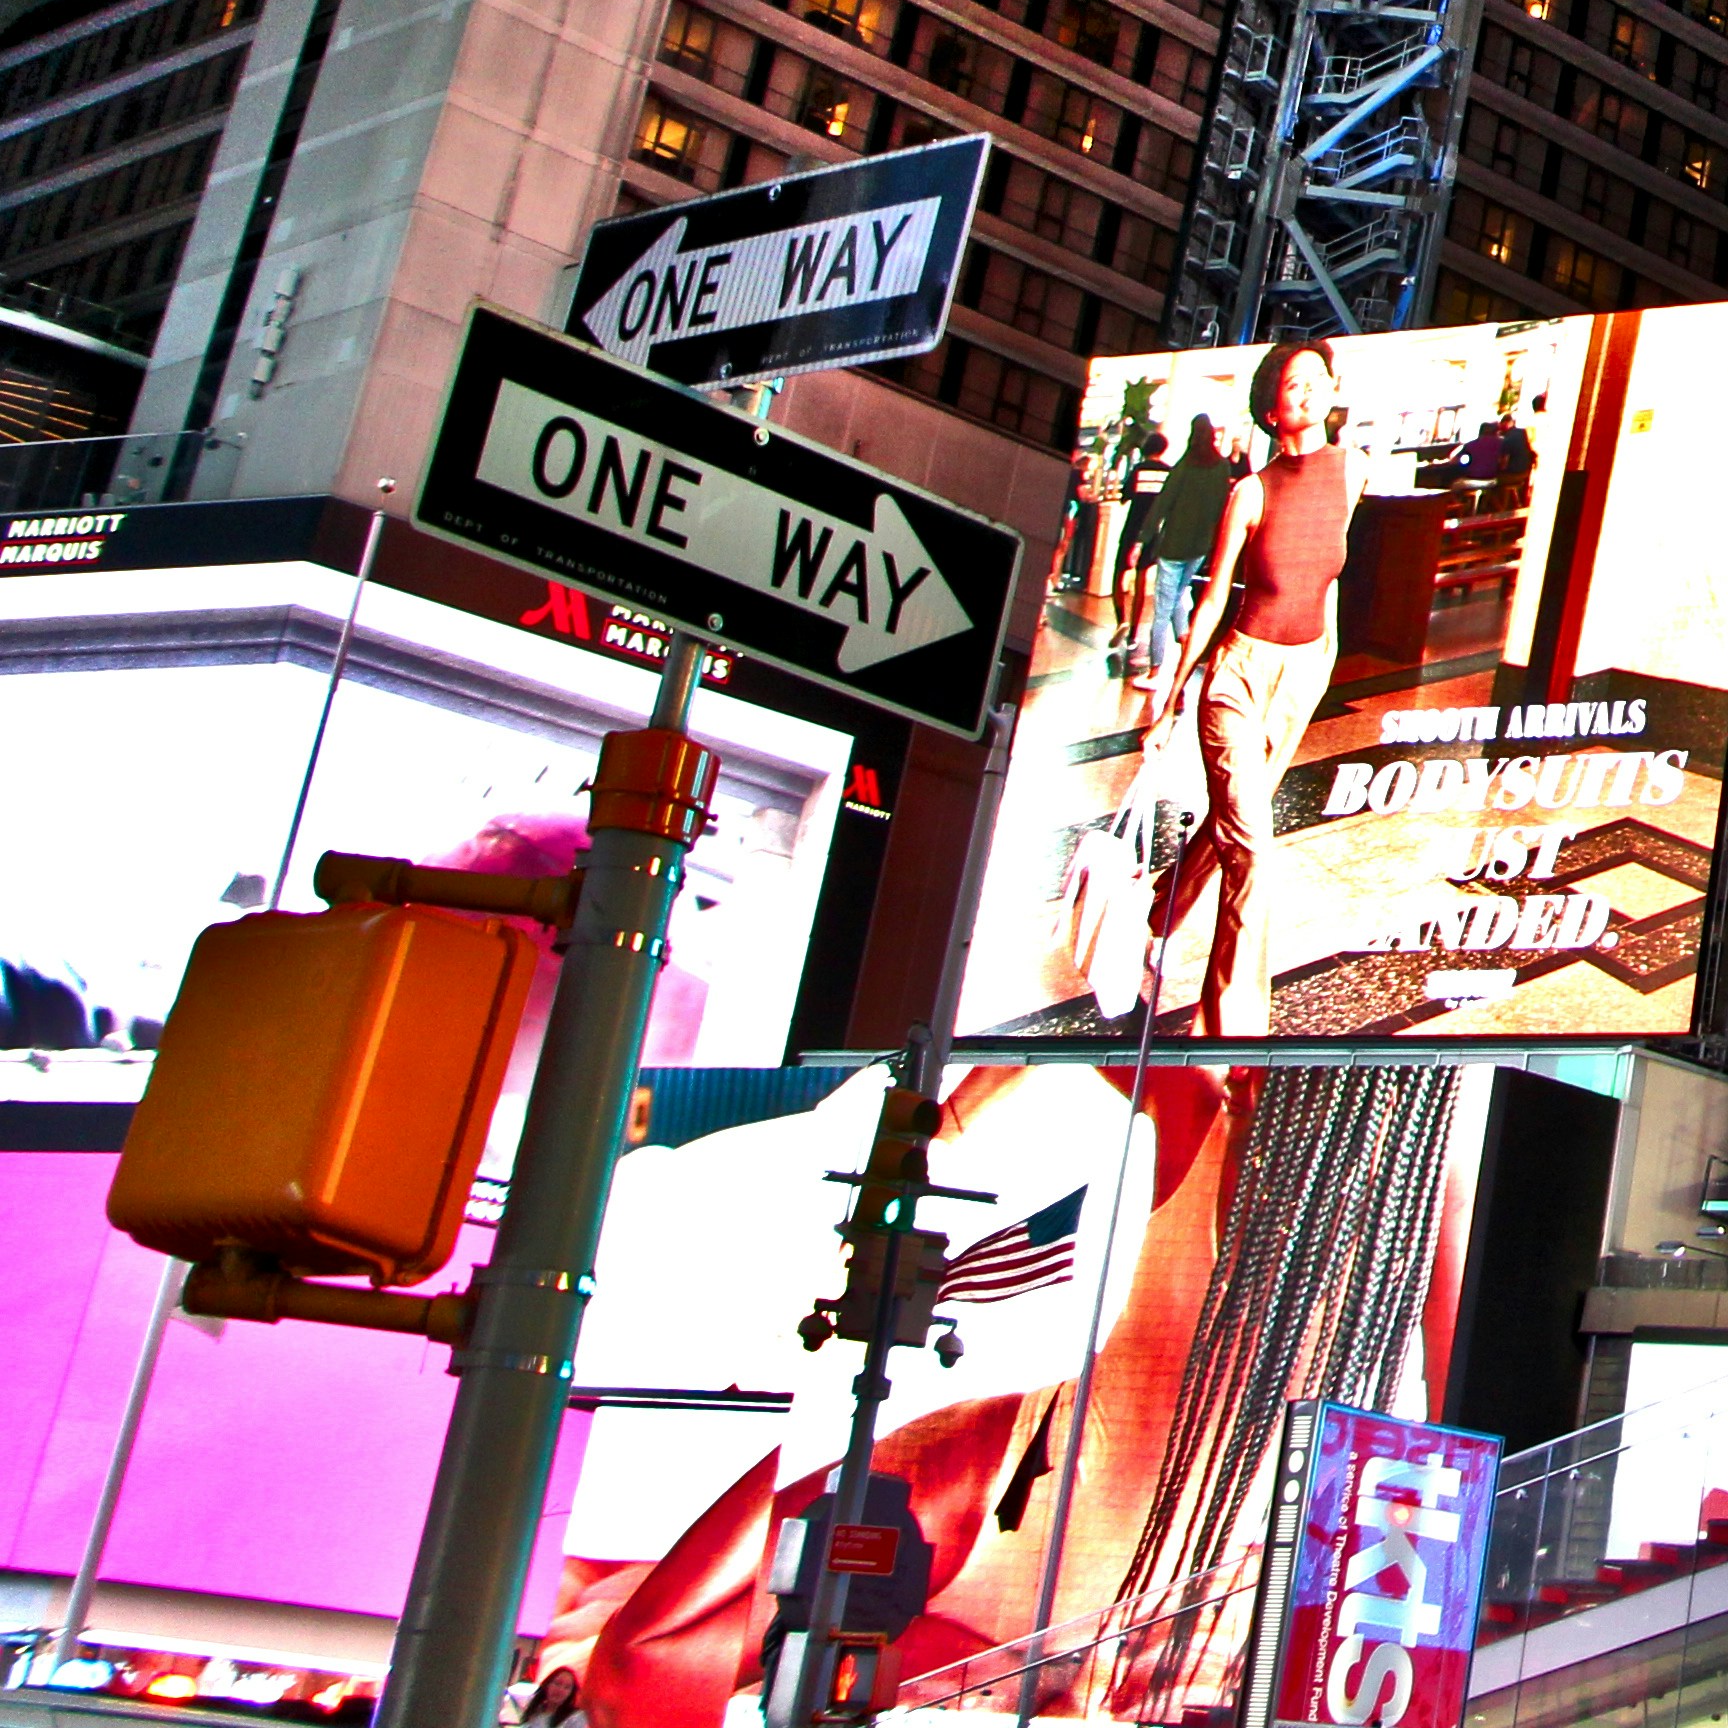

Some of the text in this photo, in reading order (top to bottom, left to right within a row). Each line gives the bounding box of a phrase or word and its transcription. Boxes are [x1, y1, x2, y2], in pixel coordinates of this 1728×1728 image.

[617, 212, 914, 344] ONE WAY
[8, 514, 128, 538] MARRIOTT
[531, 414, 706, 550] ONE
[770, 507, 932, 635] WAY
[0, 541, 104, 564] MARQUIS
[444, 511, 668, 605] DEPT OF TRANSPORTATION
[606, 624, 729, 679] MARIS
[1505, 699, 1646, 739] ARRIVALS
[845, 801, 891, 820] MARRIOTT
[1322, 750, 1689, 816] BODYSUITS
[1343, 1464, 1357, 1512] service
[1339, 1515, 1347, 1531] of
[1329, 1532, 1347, 1588] Theatre
[1327, 1454, 1462, 1724] tkts
[1316, 1591, 1337, 1682] Development
[1307, 1685, 1322, 1721] Fund
